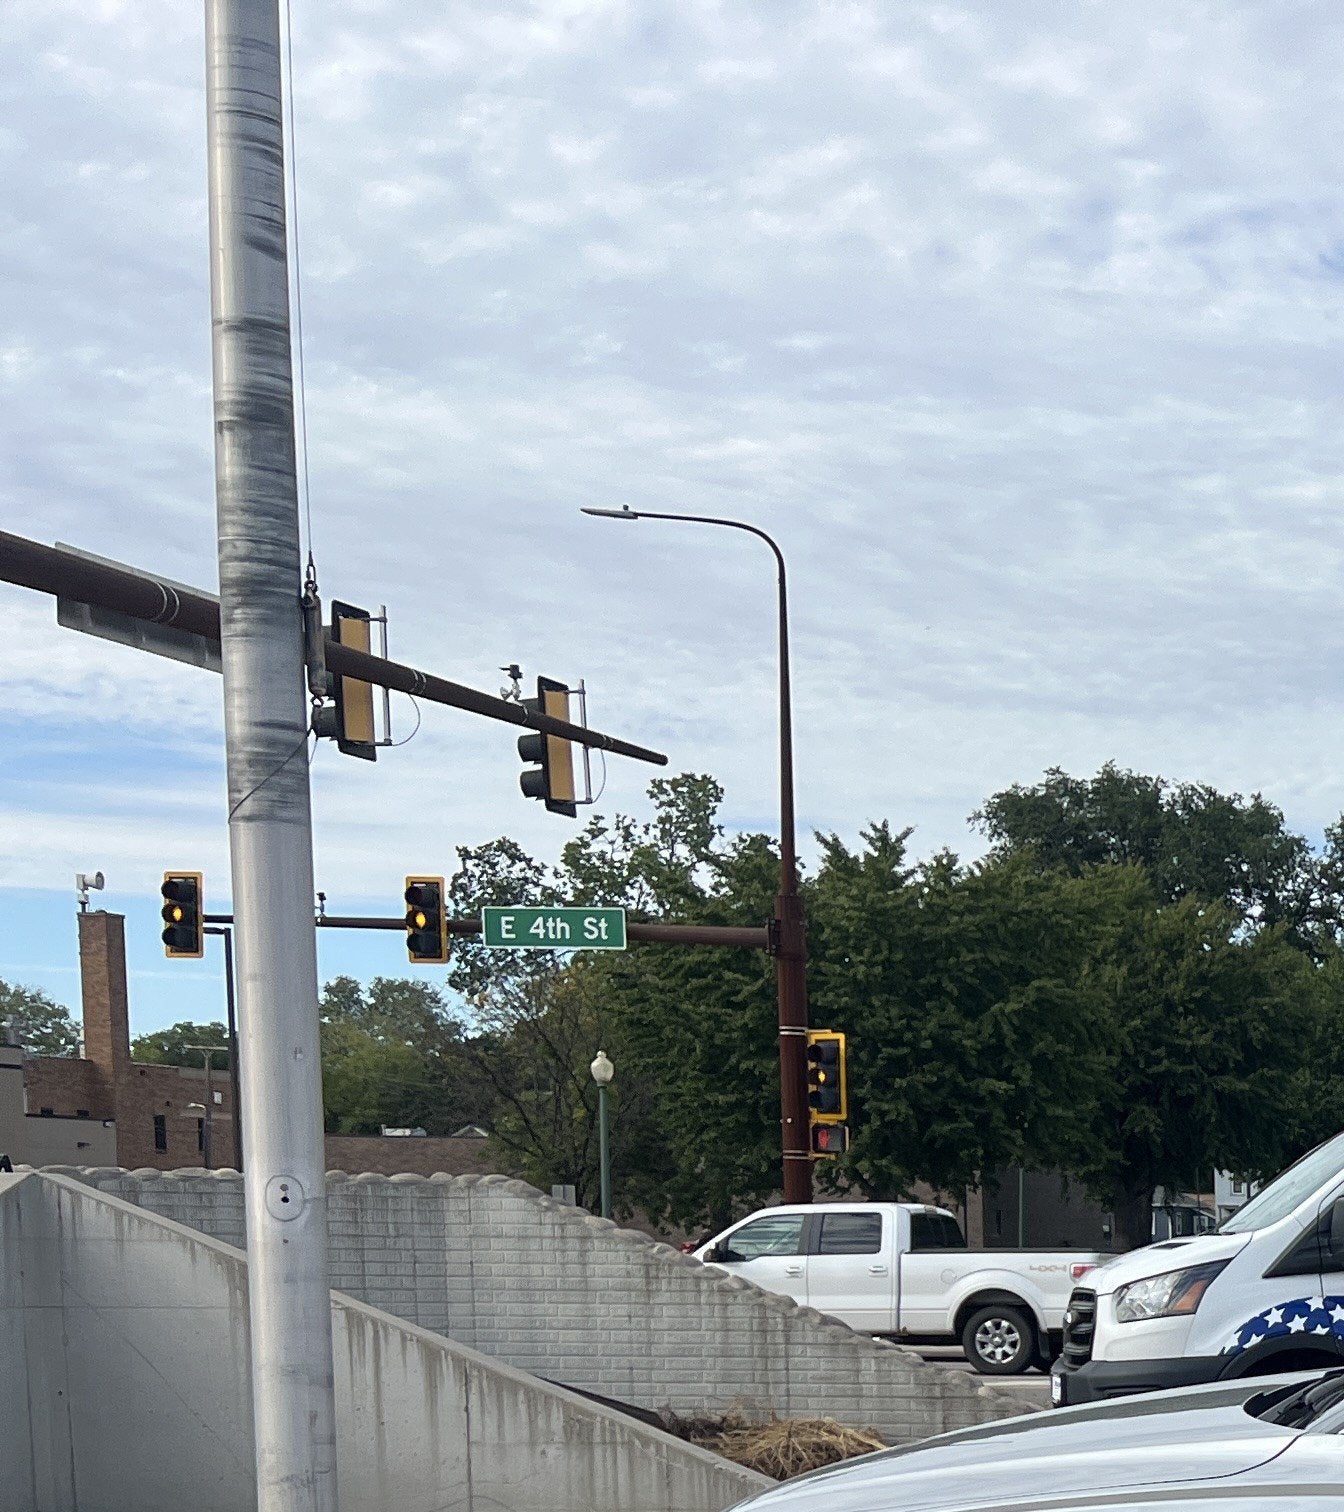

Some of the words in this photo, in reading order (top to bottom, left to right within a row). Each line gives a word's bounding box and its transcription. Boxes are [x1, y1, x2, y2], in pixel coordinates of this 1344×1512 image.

[501, 916, 516, 939] E
[529, 916, 571, 940] 4th
[583, 917, 609, 940] St
